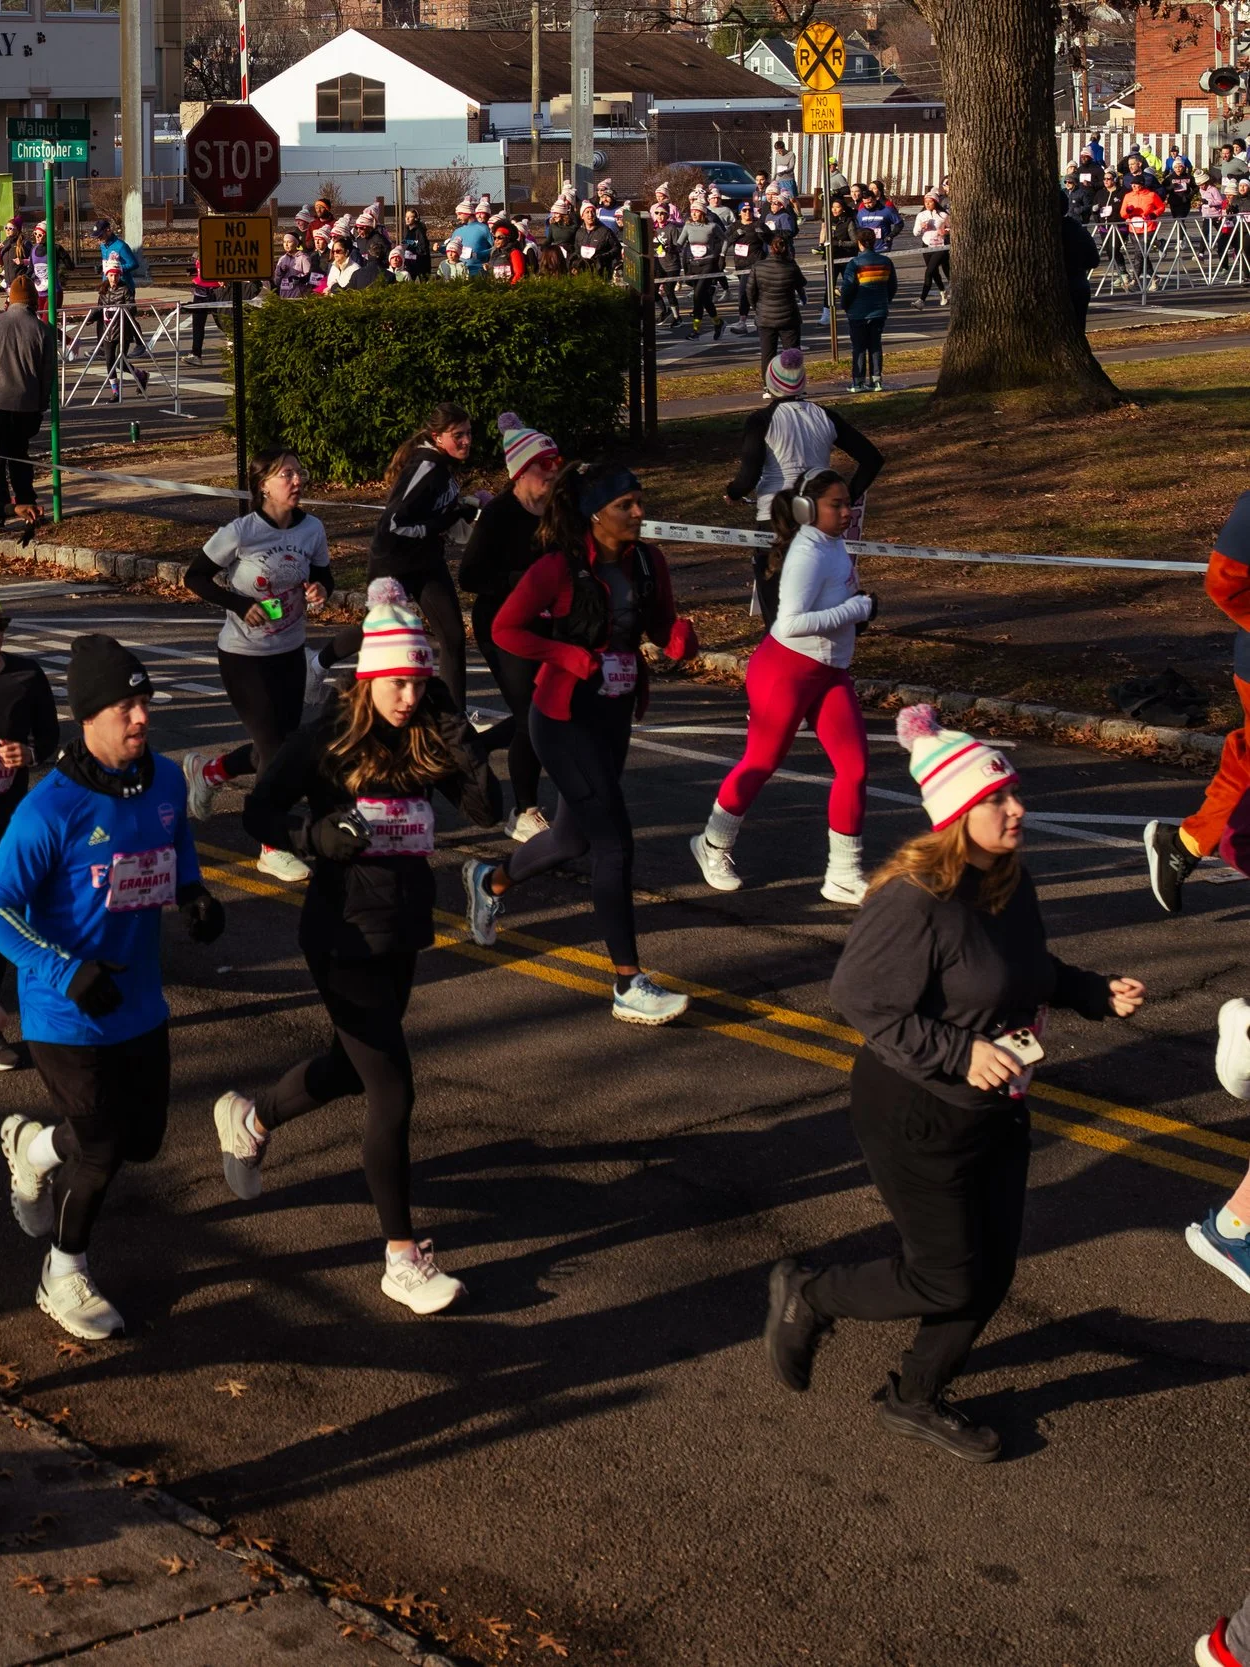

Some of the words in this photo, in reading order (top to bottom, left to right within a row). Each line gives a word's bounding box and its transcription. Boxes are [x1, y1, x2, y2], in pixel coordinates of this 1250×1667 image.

[800, 49, 810, 66] R
[832, 49, 843, 66] R
[816, 96, 828, 107] NO
[810, 108, 835, 118] TRAIN
[17, 120, 59, 136] Walnut
[811, 120, 835, 130] HORN
[17, 142, 72, 159] Christopher
[76, 146, 83, 156] St
[194, 140, 274, 179] STOP
[225, 222, 246, 238] NO
[215, 241, 259, 257] TRAIN
[216, 259, 258, 275] HORN
[373, 823, 425, 836] OUTURE
[120, 873, 170, 891] GRAMATA
